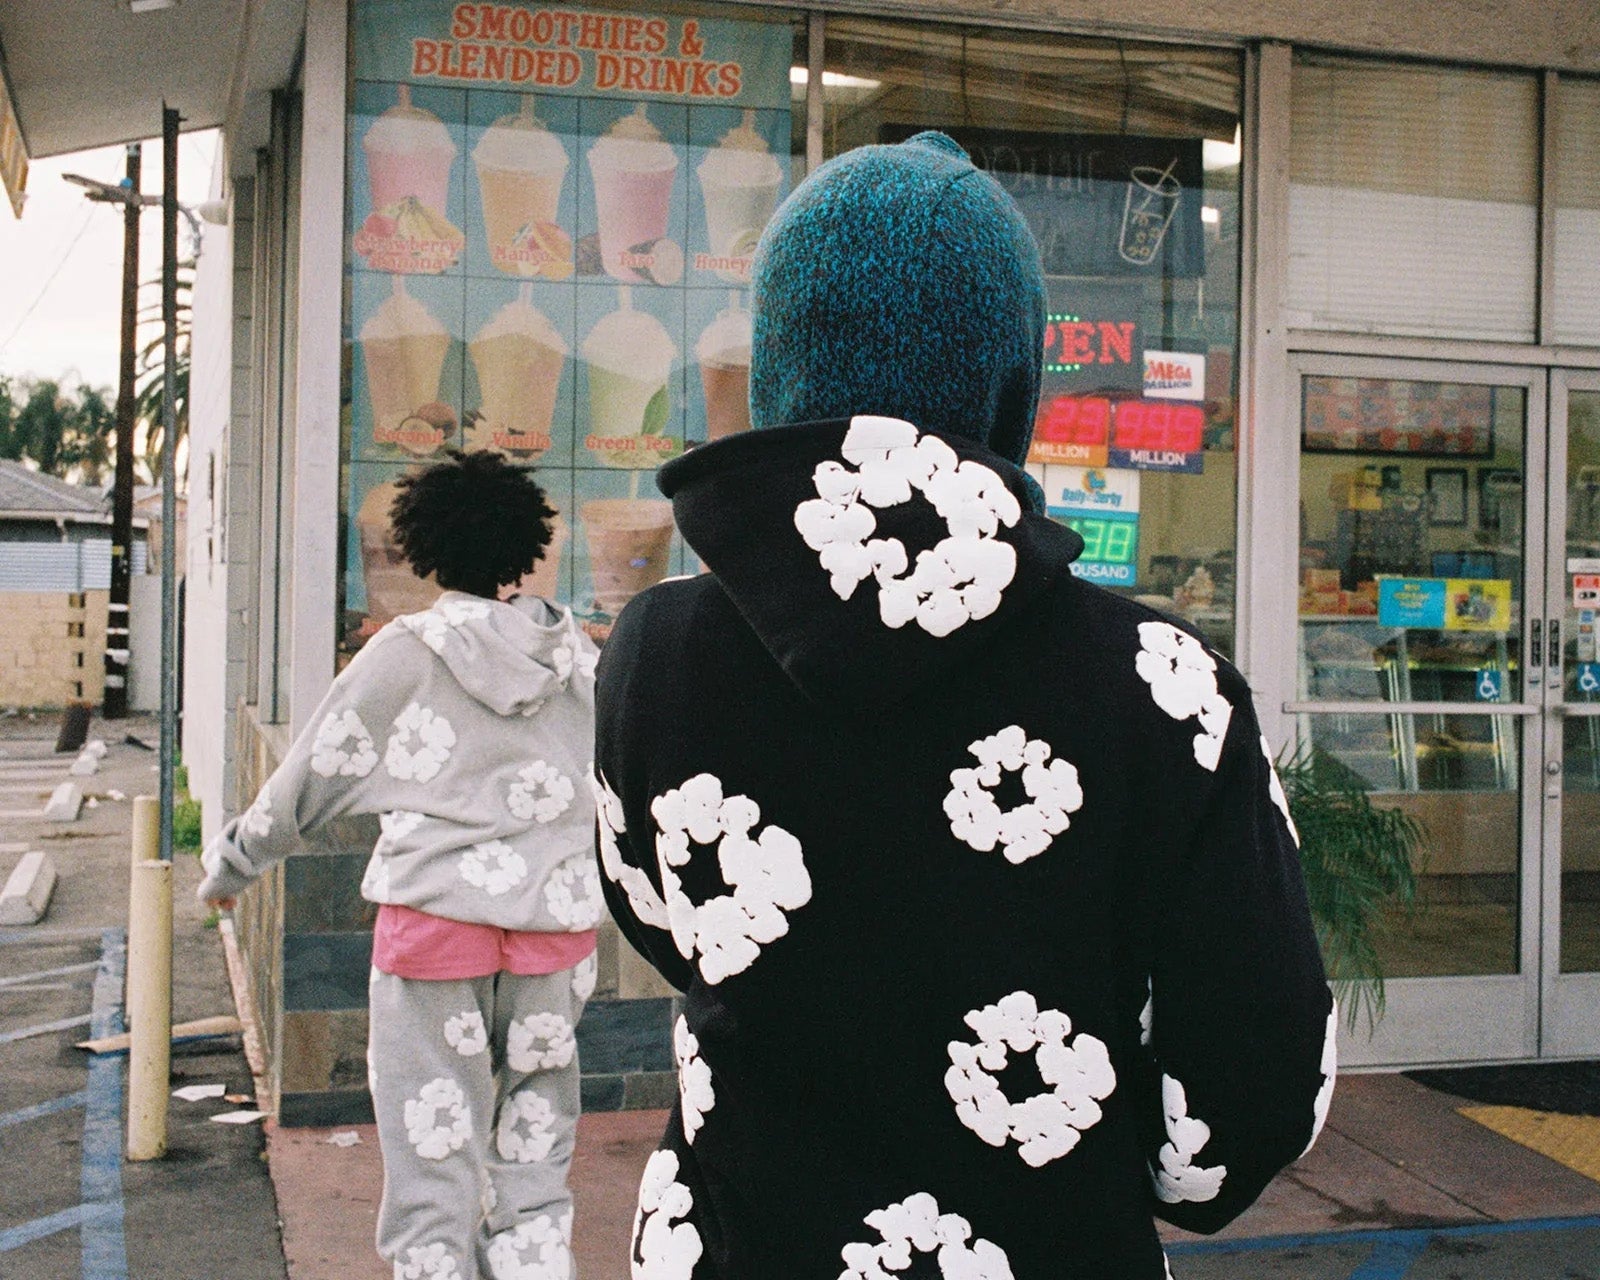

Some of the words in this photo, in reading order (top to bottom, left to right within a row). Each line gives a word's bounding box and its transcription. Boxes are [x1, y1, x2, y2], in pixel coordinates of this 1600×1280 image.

[452, 3, 668, 54] SMOOTHIES
[679, 19, 704, 56] &
[411, 38, 582, 87] BLENDED
[595, 54, 743, 98] DRINKS
[1044, 322, 1136, 364] EN
[1146, 360, 1192, 382] MEGA
[585, 434, 636, 450] Green
[644, 434, 673, 450] Tea
[1034, 443, 1090, 459] MILLION
[1130, 449, 1186, 466] MILLION
[1071, 520, 1132, 562] 38
[1068, 562, 1130, 579] OUSAND
